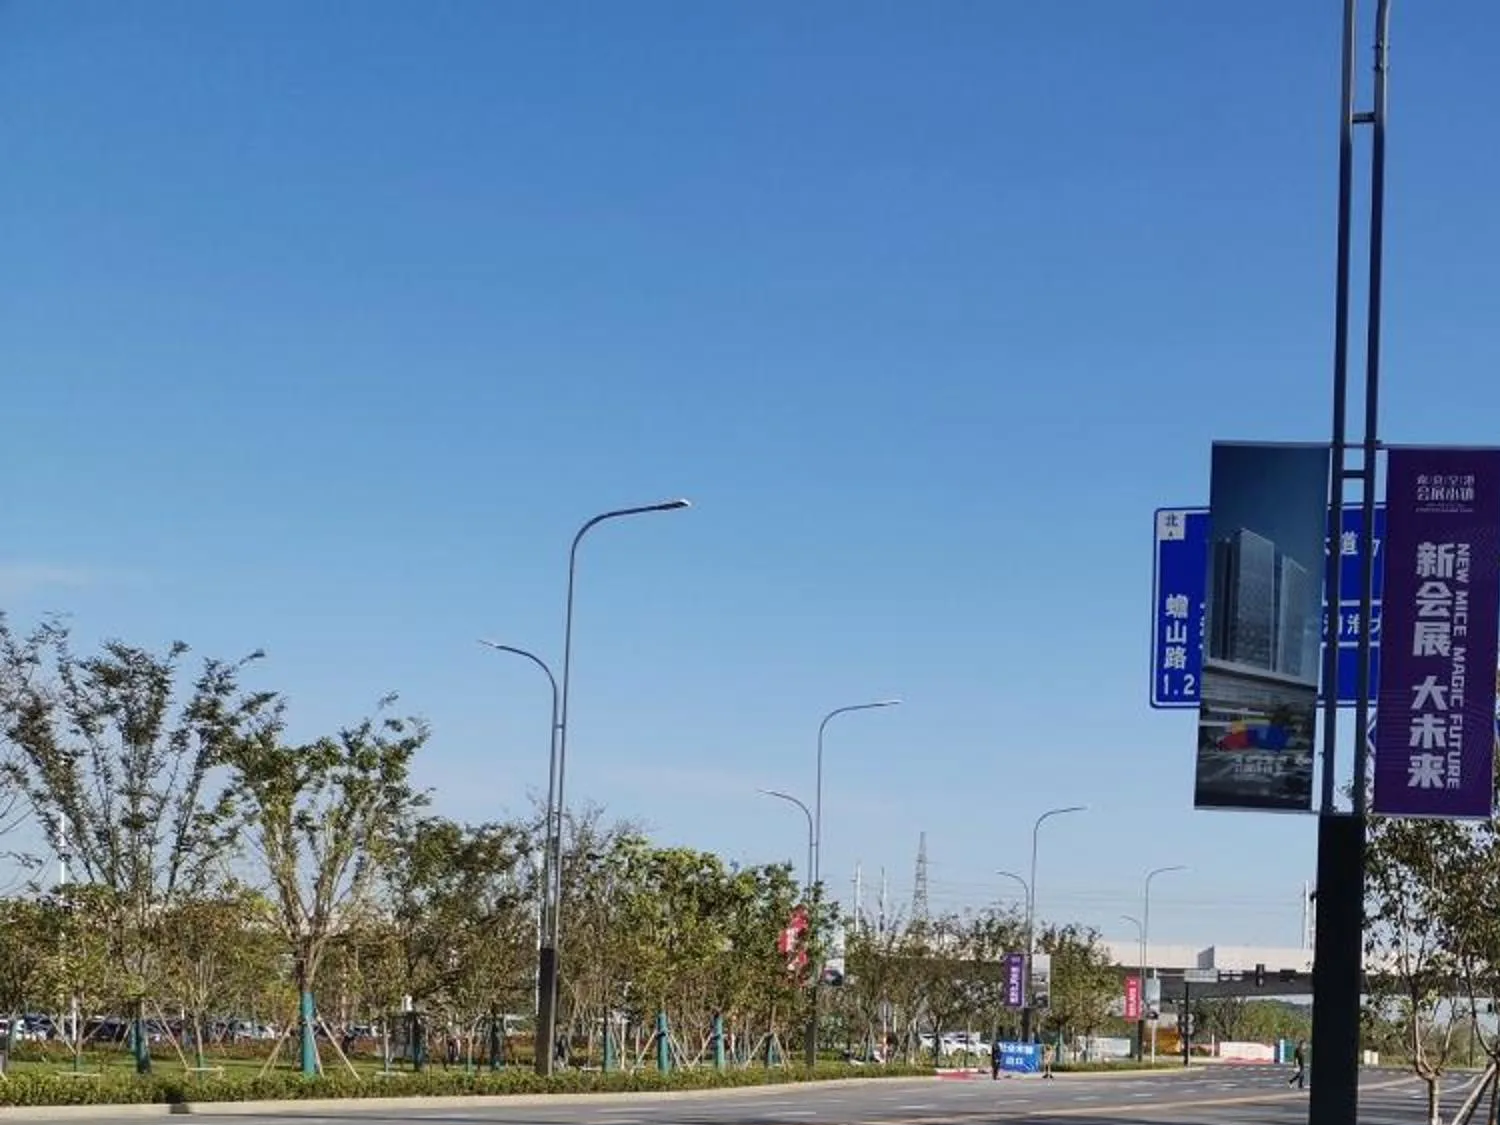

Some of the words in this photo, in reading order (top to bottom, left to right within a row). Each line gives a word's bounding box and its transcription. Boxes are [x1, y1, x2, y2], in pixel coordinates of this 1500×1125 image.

[1165, 513, 1178, 527] 北
[1455, 543, 1470, 583] NEW
[1412, 541, 1455, 657] 新会展
[1453, 590, 1468, 636] MICE
[1163, 674, 1195, 695] 1.2
[1450, 647, 1466, 707] MAGIC
[1407, 675, 1449, 789] 大未来
[1446, 713, 1463, 789] FUTURE
